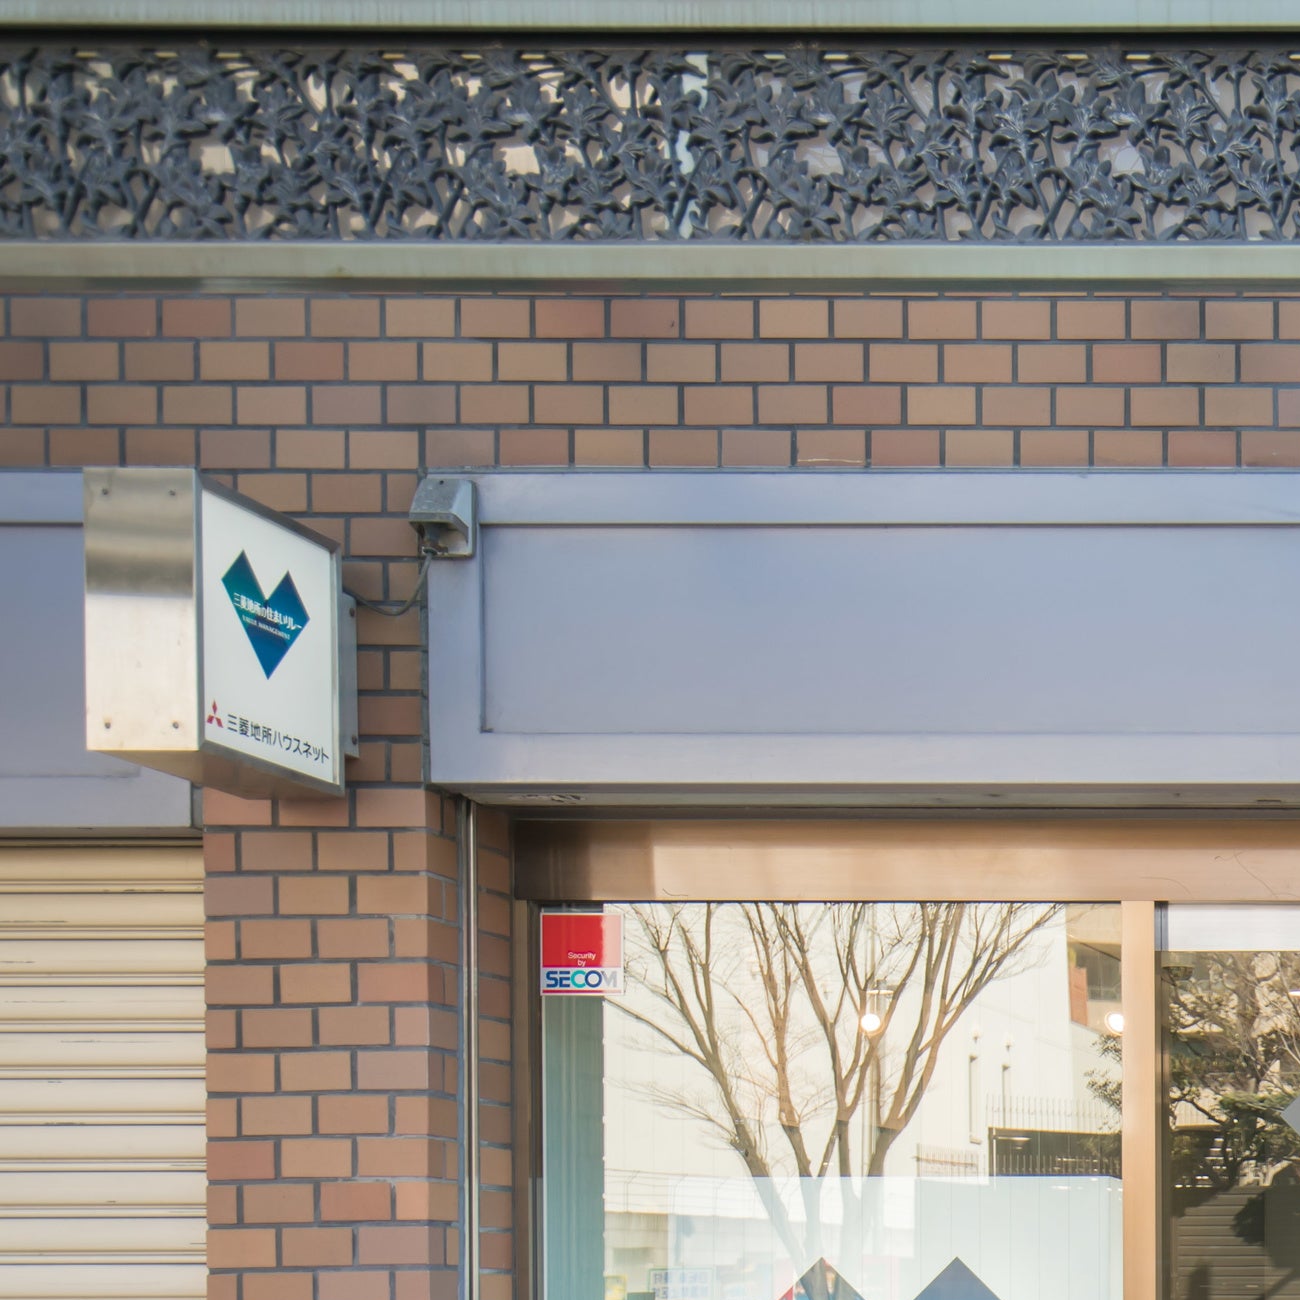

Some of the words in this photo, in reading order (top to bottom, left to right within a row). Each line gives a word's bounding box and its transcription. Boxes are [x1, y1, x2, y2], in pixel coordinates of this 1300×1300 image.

[227, 713, 329, 764] 三菱地所ハウスネット
[567, 951, 597, 961] Security
[577, 959, 587, 967] by
[545, 970, 618, 989] SECOM
